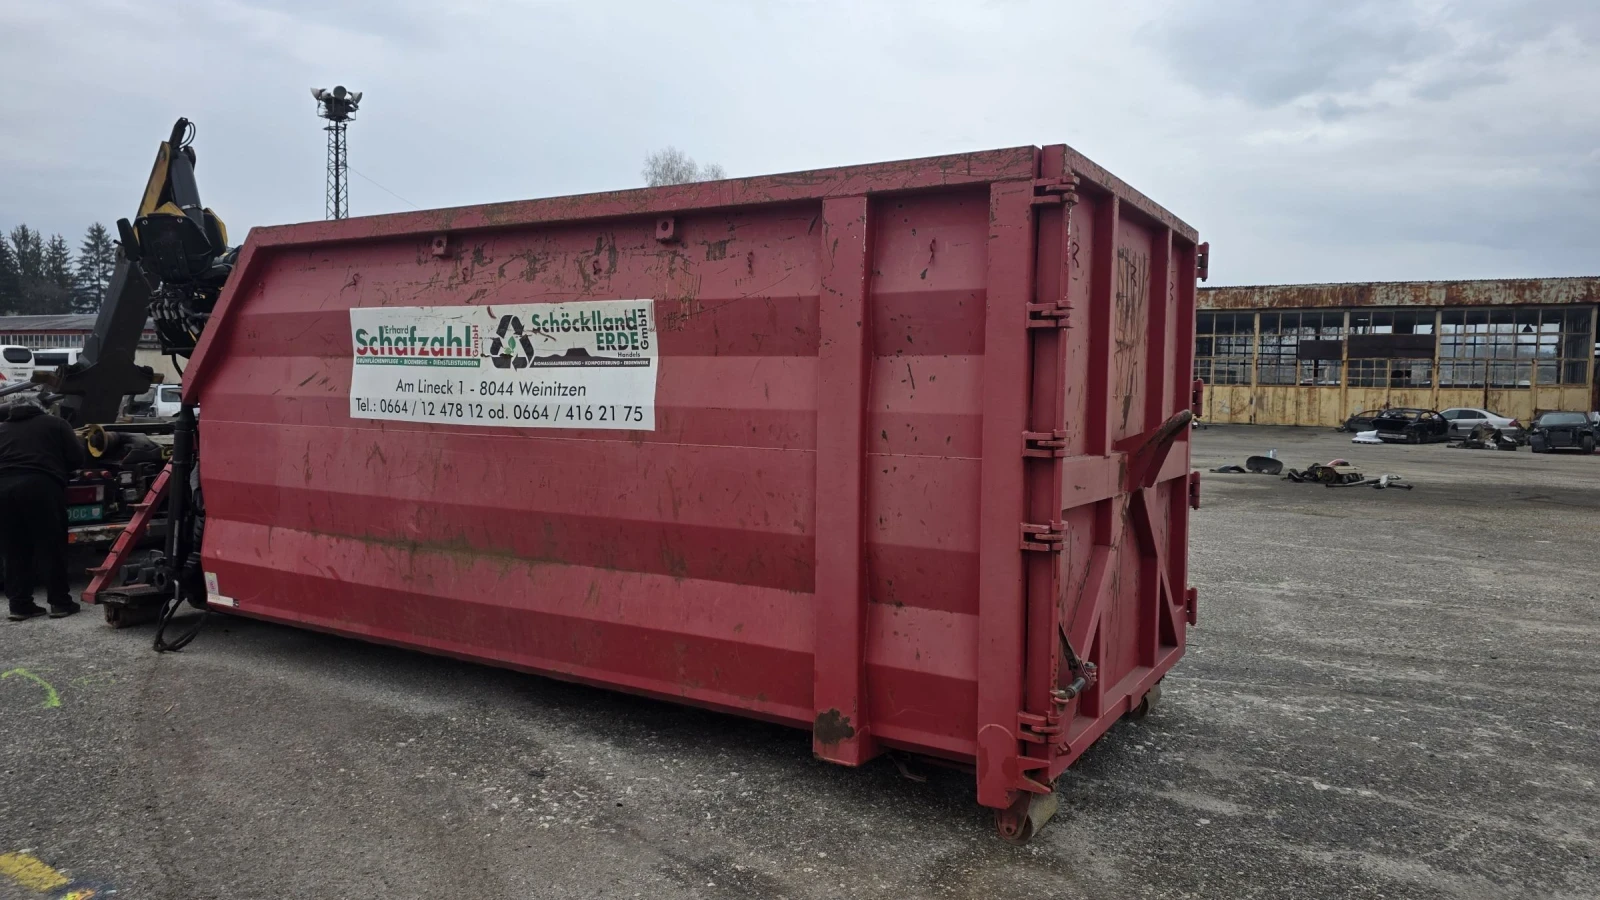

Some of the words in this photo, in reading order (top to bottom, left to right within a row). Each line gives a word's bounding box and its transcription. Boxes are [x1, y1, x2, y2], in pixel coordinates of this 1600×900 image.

[384, 324, 409, 335] Erhard
[531, 309, 638, 333] Schöcklland
[638, 308, 649, 350] GmbH
[355, 325, 471, 357] Schafzahl
[595, 331, 640, 351] ERDE
[433, 359, 478, 367] DIENSTLEISTUNGEN
[396, 378, 414, 393] Am
[417, 378, 454, 395] Lineck
[459, 380, 463, 395] 1
[479, 381, 514, 396] 8044
[518, 380, 586, 397] Weinitzen
[355, 397, 377, 412] Tel.:
[380, 399, 408, 414] 0664
[411, 400, 417, 416] /
[421, 401, 436, 416] 12
[440, 402, 463, 418] 478
[468, 403, 484, 418] 12
[488, 403, 508, 419] od.
[513, 404, 549, 420] 0664
[553, 404, 561, 421] /
[565, 405, 593, 421] 416
[598, 405, 615, 421] 21
[623, 405, 643, 421] 75
